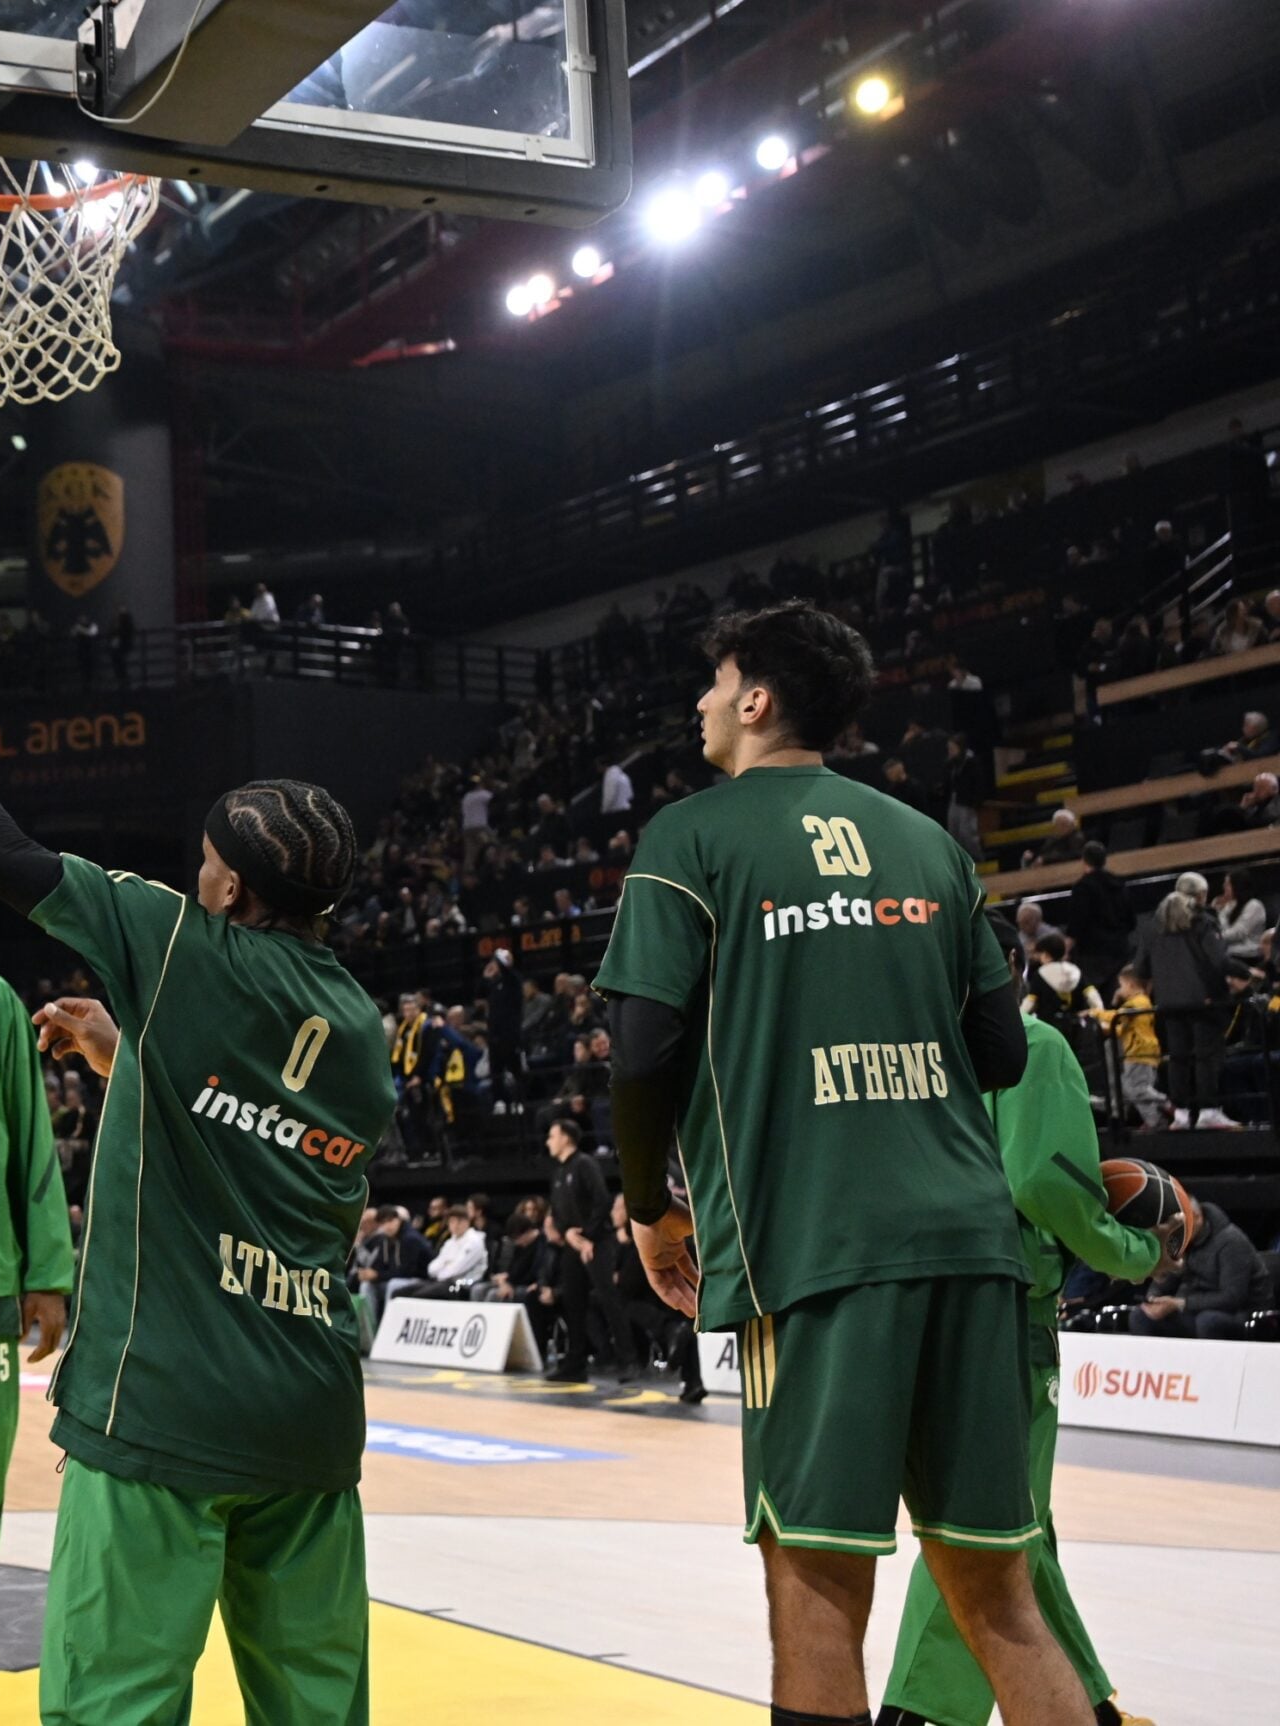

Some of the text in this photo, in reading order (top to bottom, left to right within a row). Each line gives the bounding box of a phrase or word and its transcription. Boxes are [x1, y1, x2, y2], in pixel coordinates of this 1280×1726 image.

[24, 710, 147, 756] arena
[801, 814, 872, 878] 20
[760, 890, 940, 942] instacar
[280, 1014, 331, 1093] 0
[811, 1042, 949, 1105] ATHENS
[190, 1074, 366, 1168] instacar
[396, 1317, 459, 1349] Allianz
[1104, 1369, 1198, 1403] SUNEL
